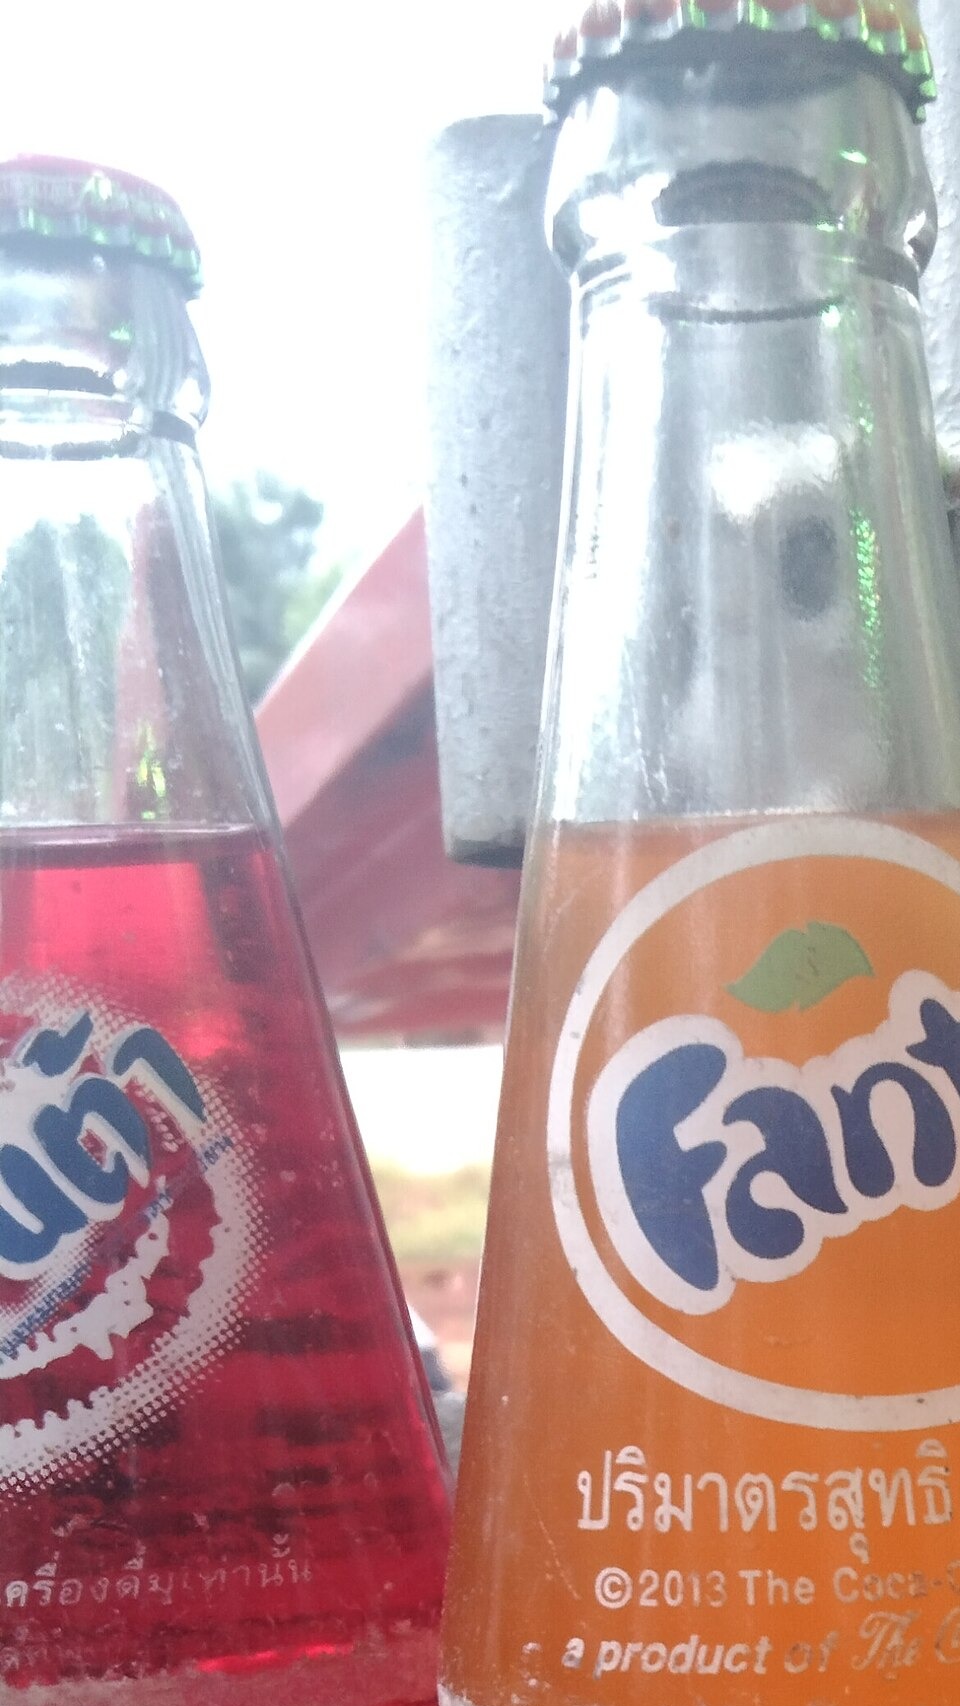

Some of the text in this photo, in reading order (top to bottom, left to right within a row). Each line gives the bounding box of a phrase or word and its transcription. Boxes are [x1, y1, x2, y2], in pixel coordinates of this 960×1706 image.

[576, 1437, 953, 1565] ปริมาตรสุทธิ
[738, 1567, 816, 1606] The
[560, 1636, 586, 1670] a
[593, 1633, 772, 1681] product
[783, 1630, 840, 1674] of
[850, 1609, 924, 1673] The
